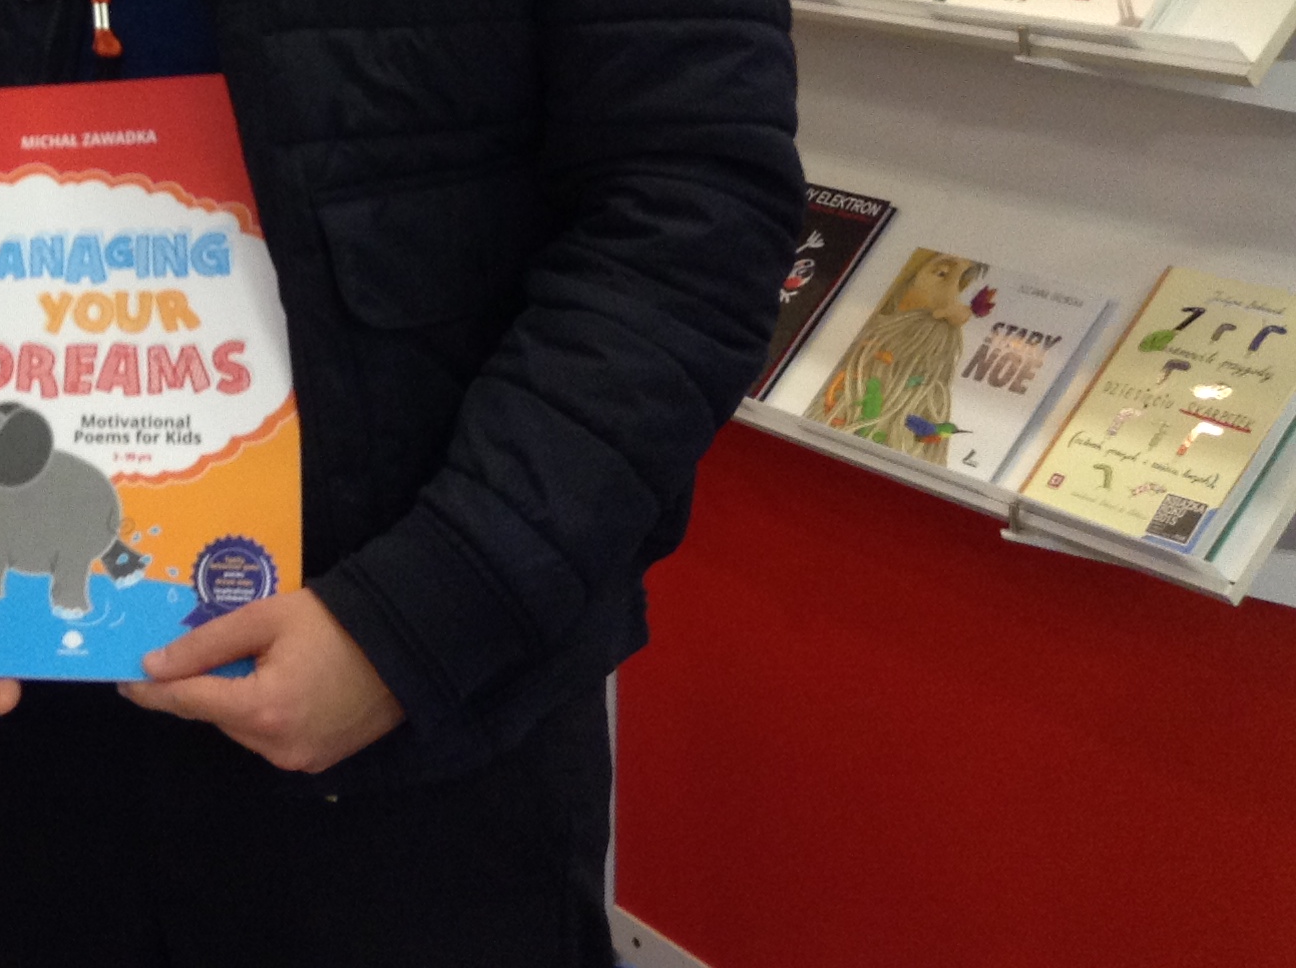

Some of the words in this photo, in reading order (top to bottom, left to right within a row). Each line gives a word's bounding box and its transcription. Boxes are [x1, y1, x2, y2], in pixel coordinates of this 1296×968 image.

[816, 190, 882, 217] ELEKTRON
[37, 288, 202, 335] YOUR
[961, 343, 1044, 394] NOE
[81, 414, 191, 429] Motivational
[74, 430, 130, 444] Poems
[135, 430, 160, 444] for
[166, 430, 202, 444] Kids
